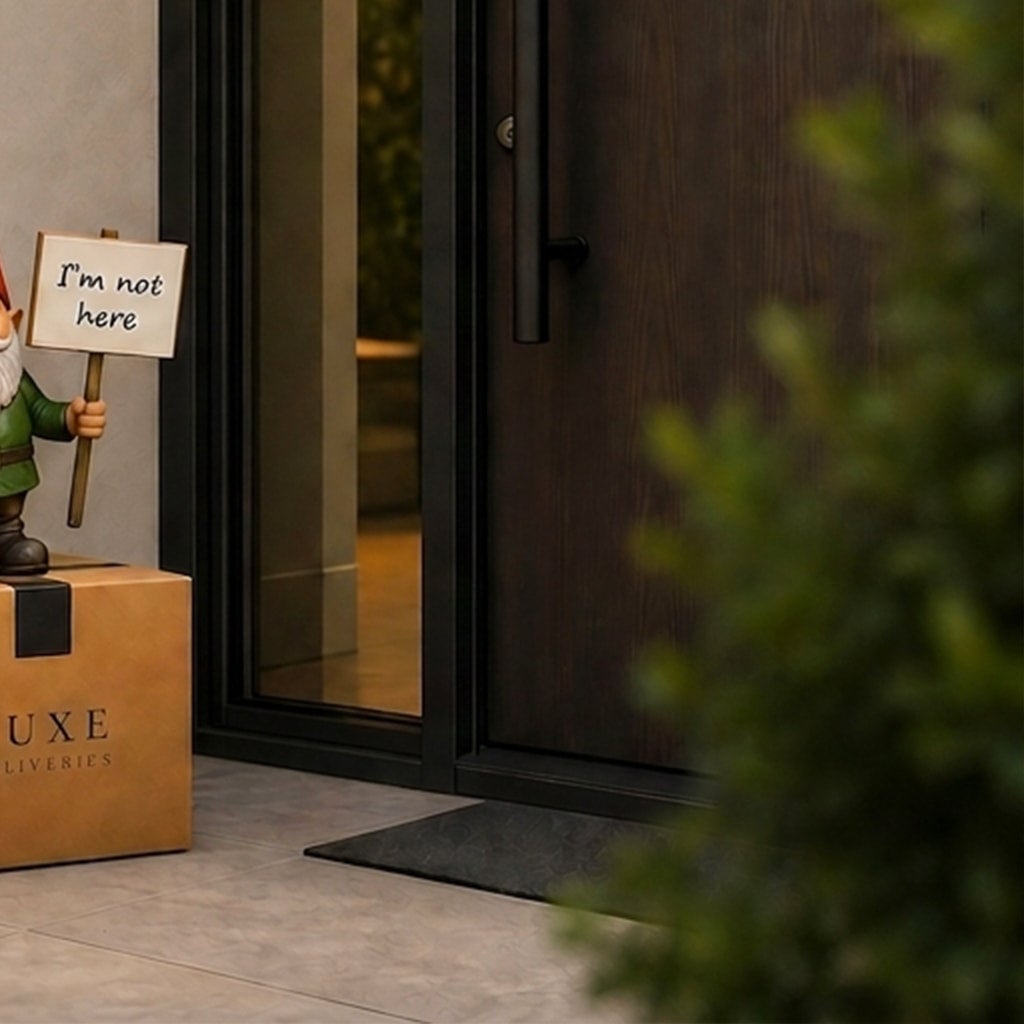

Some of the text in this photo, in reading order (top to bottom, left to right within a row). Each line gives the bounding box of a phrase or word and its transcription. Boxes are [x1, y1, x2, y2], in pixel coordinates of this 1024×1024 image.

[56, 262, 163, 296] I'm not
[76, 301, 137, 330] here
